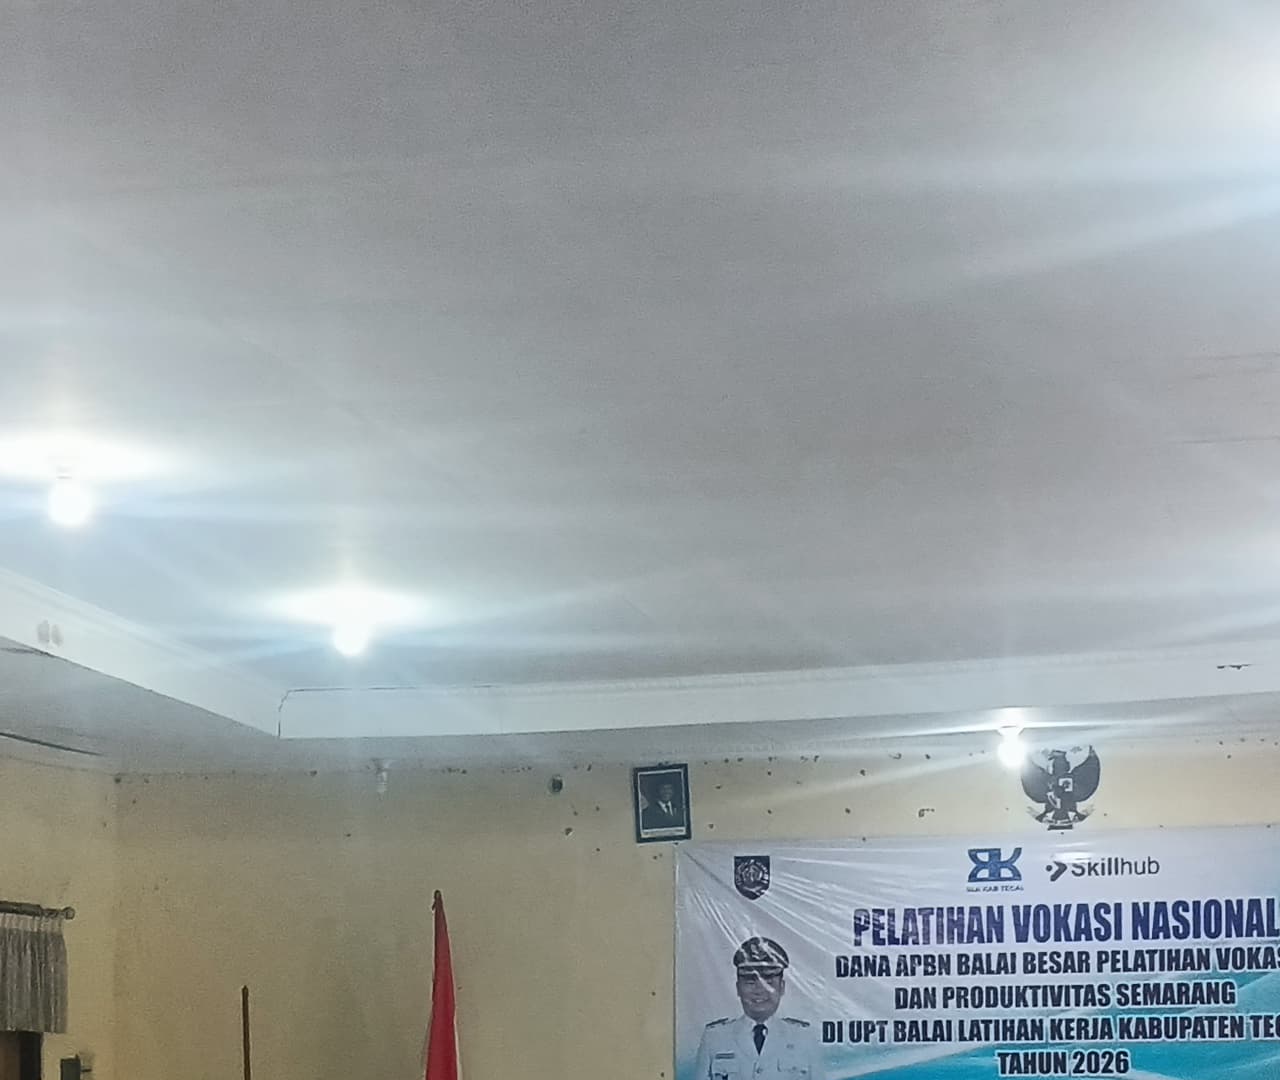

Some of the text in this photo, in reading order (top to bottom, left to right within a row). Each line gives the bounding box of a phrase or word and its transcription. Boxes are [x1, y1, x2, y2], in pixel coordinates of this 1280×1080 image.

[1071, 856, 1160, 877] Skillhub
[853, 898, 1280, 946] PELATIHAN VOKASI NASIONAL
[835, 955, 891, 978] DANA
[895, 954, 951, 977] APBN
[957, 952, 1017, 976] BALAI
[1023, 951, 1091, 975] BESAR
[1097, 948, 1211, 973] PELATIHAN
[895, 981, 1236, 1010] DAN PRODUKTIVITAS SEMARANG
[822, 1021, 843, 1043] DI
[849, 1020, 888, 1043] UPT
[894, 1019, 952, 1042] BALAI
[958, 1018, 1044, 1042] LATIHAN
[1049, 1017, 1113, 1041] KERJA
[1119, 1015, 1244, 1040] KABUPATEN
[997, 1051, 1130, 1075] TAHUN 2026
